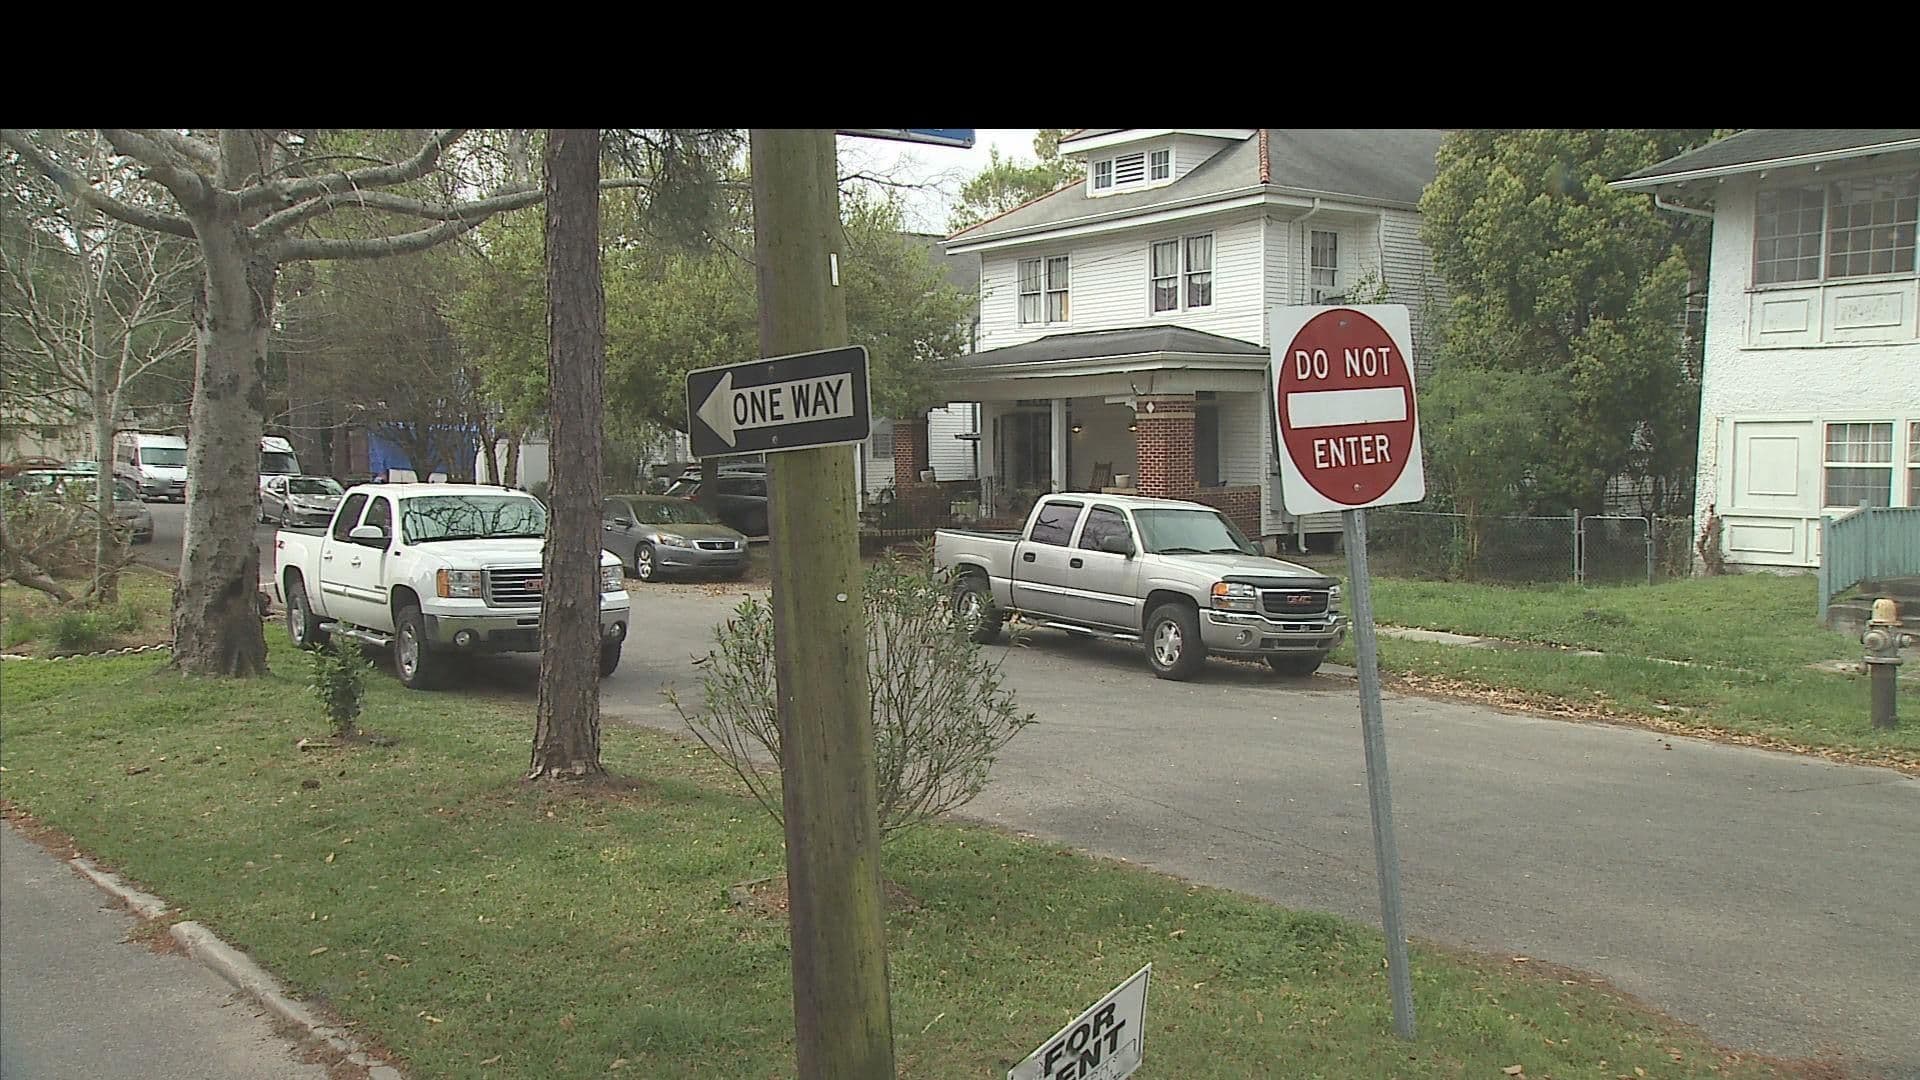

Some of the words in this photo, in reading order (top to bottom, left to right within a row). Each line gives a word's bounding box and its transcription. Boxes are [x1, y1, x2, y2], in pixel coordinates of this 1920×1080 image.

[1295, 348, 1329, 380] DO
[1344, 347, 1391, 378] NOT
[733, 387, 784, 426] ONE
[791, 378, 844, 419] WAY
[1313, 434, 1392, 469] ENTER
[1043, 1002, 1116, 1078] FOR
[1055, 1018, 1126, 1080] ENT
